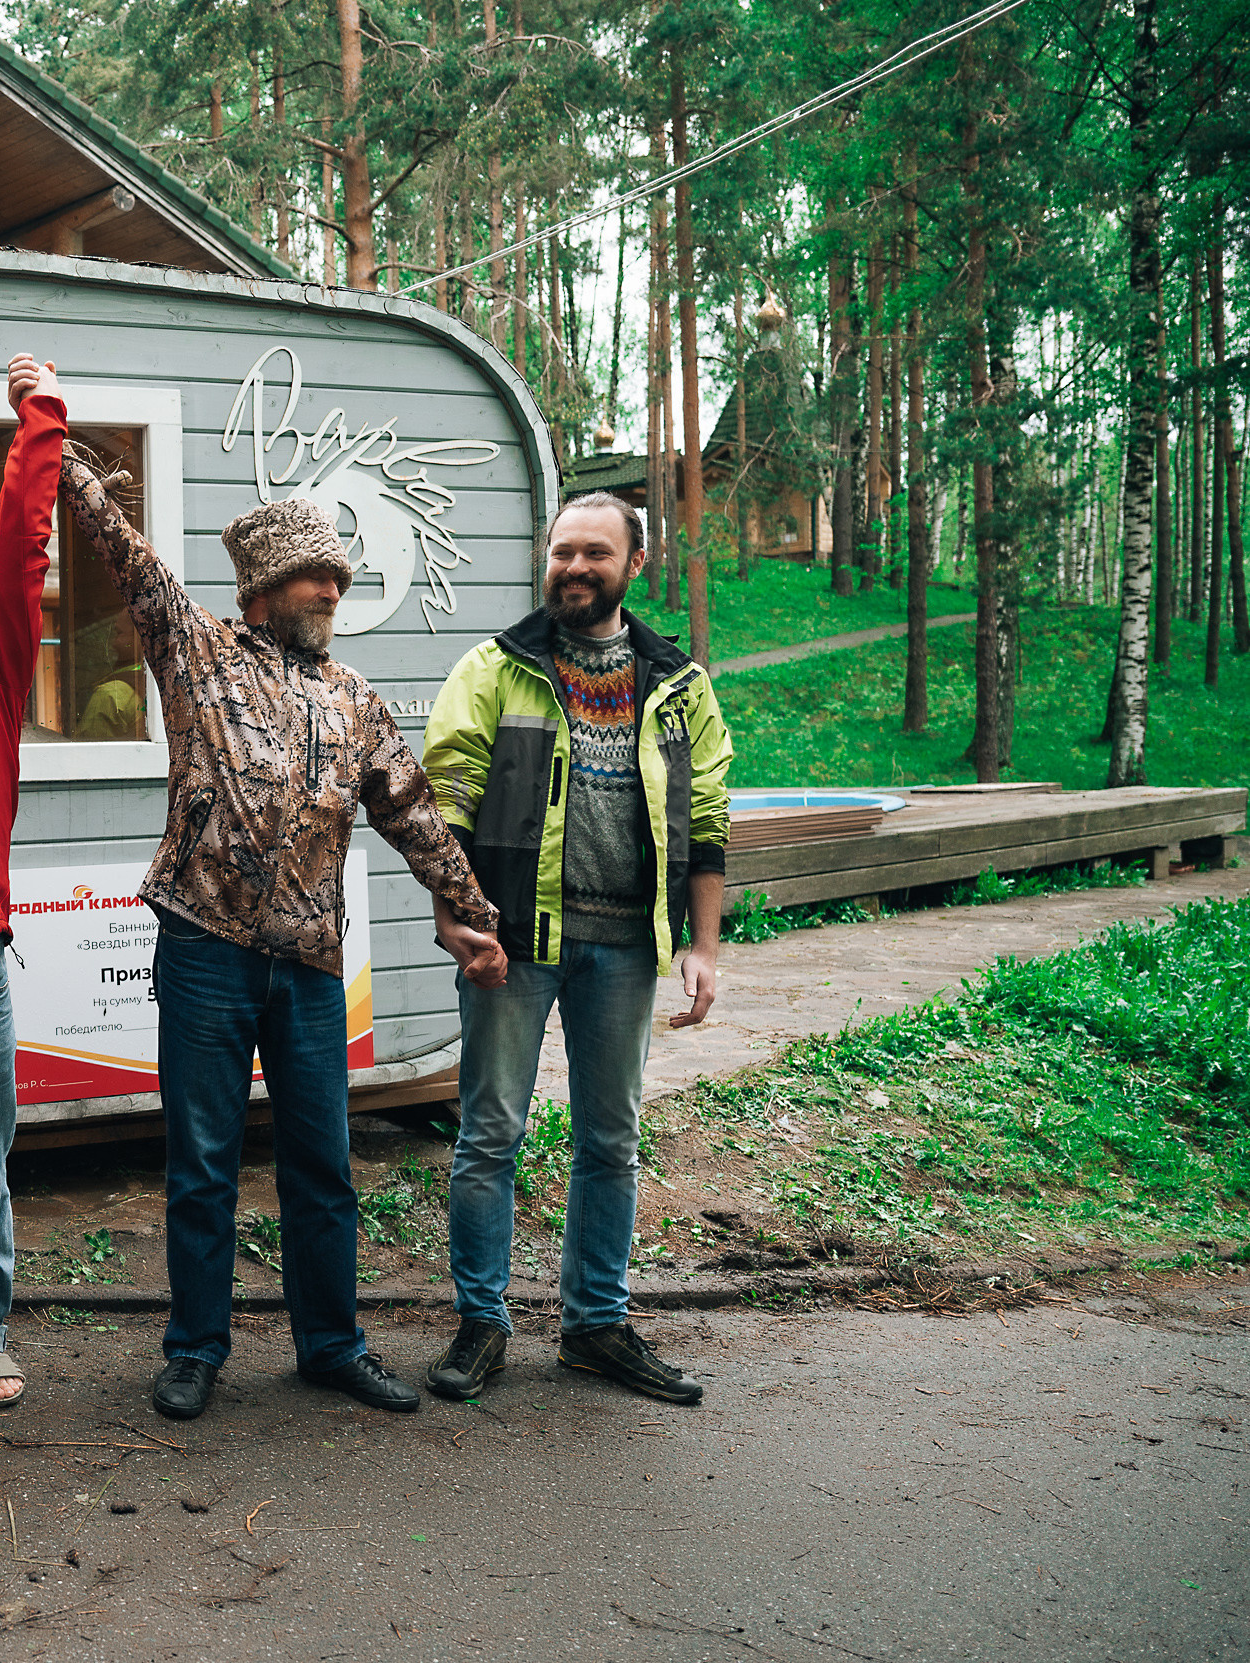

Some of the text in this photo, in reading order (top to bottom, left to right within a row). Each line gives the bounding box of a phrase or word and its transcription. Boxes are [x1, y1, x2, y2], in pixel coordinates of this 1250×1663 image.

[9, 897, 84, 915] РОДНЫЙ
[77, 936, 158, 951] «Звезды про
[93, 997, 107, 1007] На
[109, 996, 142, 1008] сумму
[55, 1022, 123, 1036] Победителю
